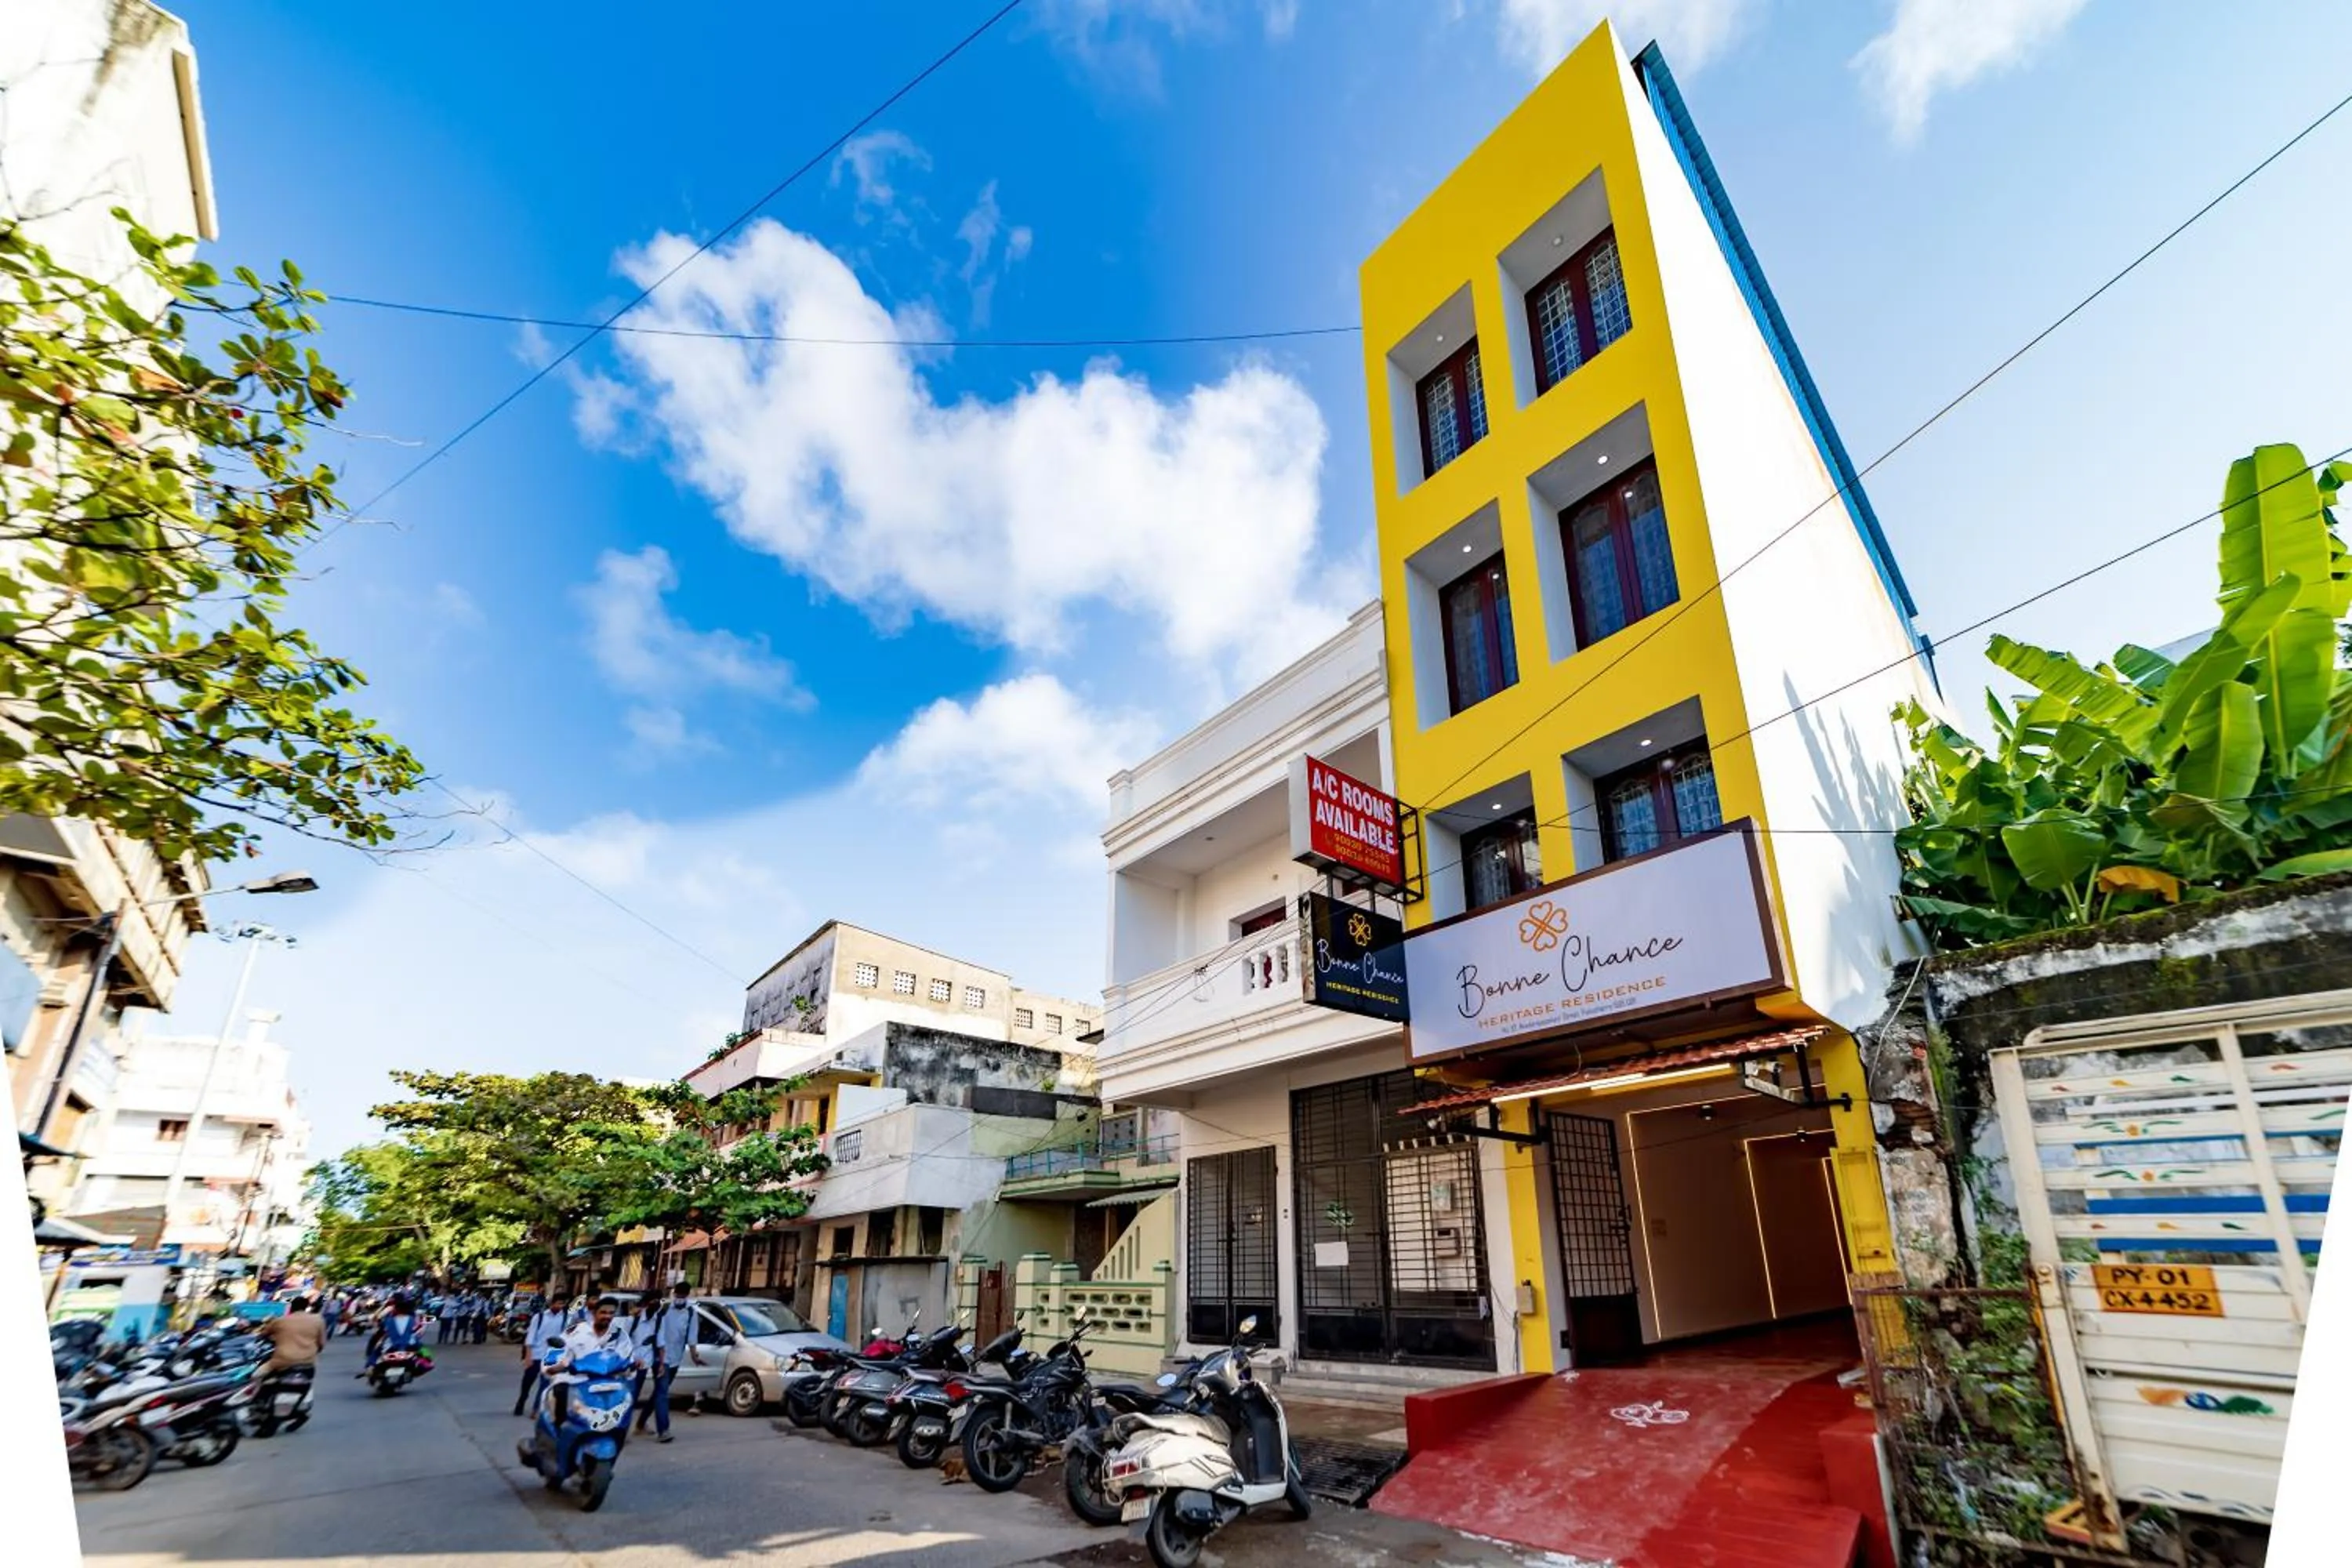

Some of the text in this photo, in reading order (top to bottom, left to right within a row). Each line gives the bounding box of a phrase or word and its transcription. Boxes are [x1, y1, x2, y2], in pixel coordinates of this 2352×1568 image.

[1312, 768, 1394, 826] A/C ROOMS
[1316, 798, 1396, 855] AVAILABLE
[1317, 938, 1404, 984] Bonne Chance
[1456, 964, 1550, 1018] Bonne
[1561, 935, 1683, 993] Chance
[1326, 981, 1399, 1004] HERITAGE RESIDENCE
[1478, 1003, 1555, 1029] HERITAGE
[1561, 976, 1667, 1009] RESIDENCE
